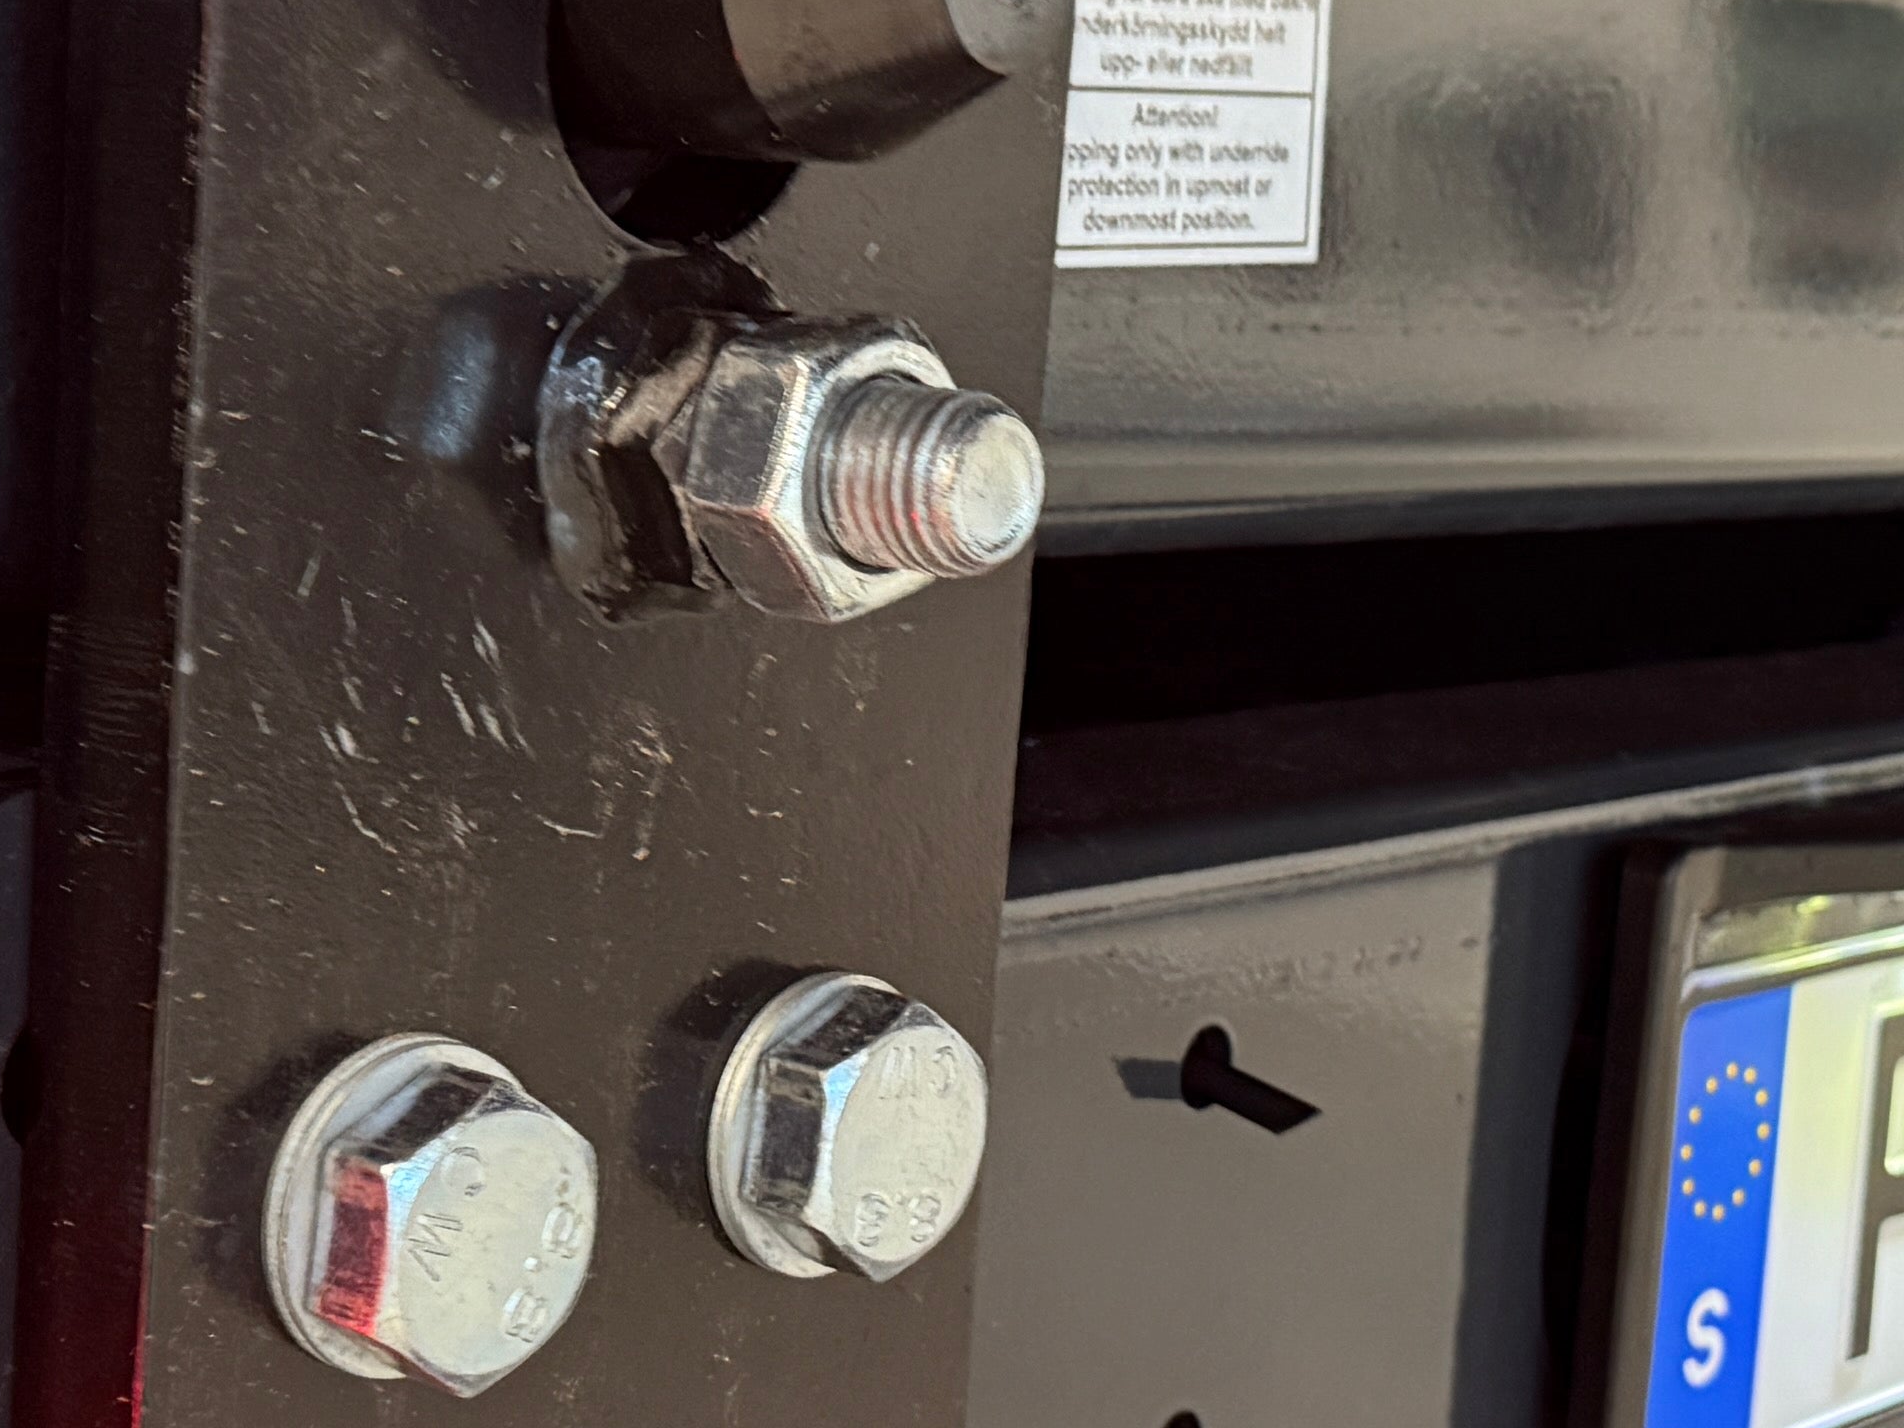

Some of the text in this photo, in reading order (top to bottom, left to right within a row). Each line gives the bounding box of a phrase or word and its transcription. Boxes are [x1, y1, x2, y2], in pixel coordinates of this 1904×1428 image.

[1255, 18, 1286, 45] helt
[1100, 52, 1142, 80] upp-
[1147, 48, 1185, 76] eller
[1132, 102, 1220, 129] Attention!
[1125, 138, 1161, 169] only
[1168, 138, 1204, 163] with
[1209, 139, 1290, 164] underride
[1068, 172, 1272, 204] protection in upmost or
[1083, 206, 1255, 236] downmost position.
[1683, 1287, 1730, 1388] S
